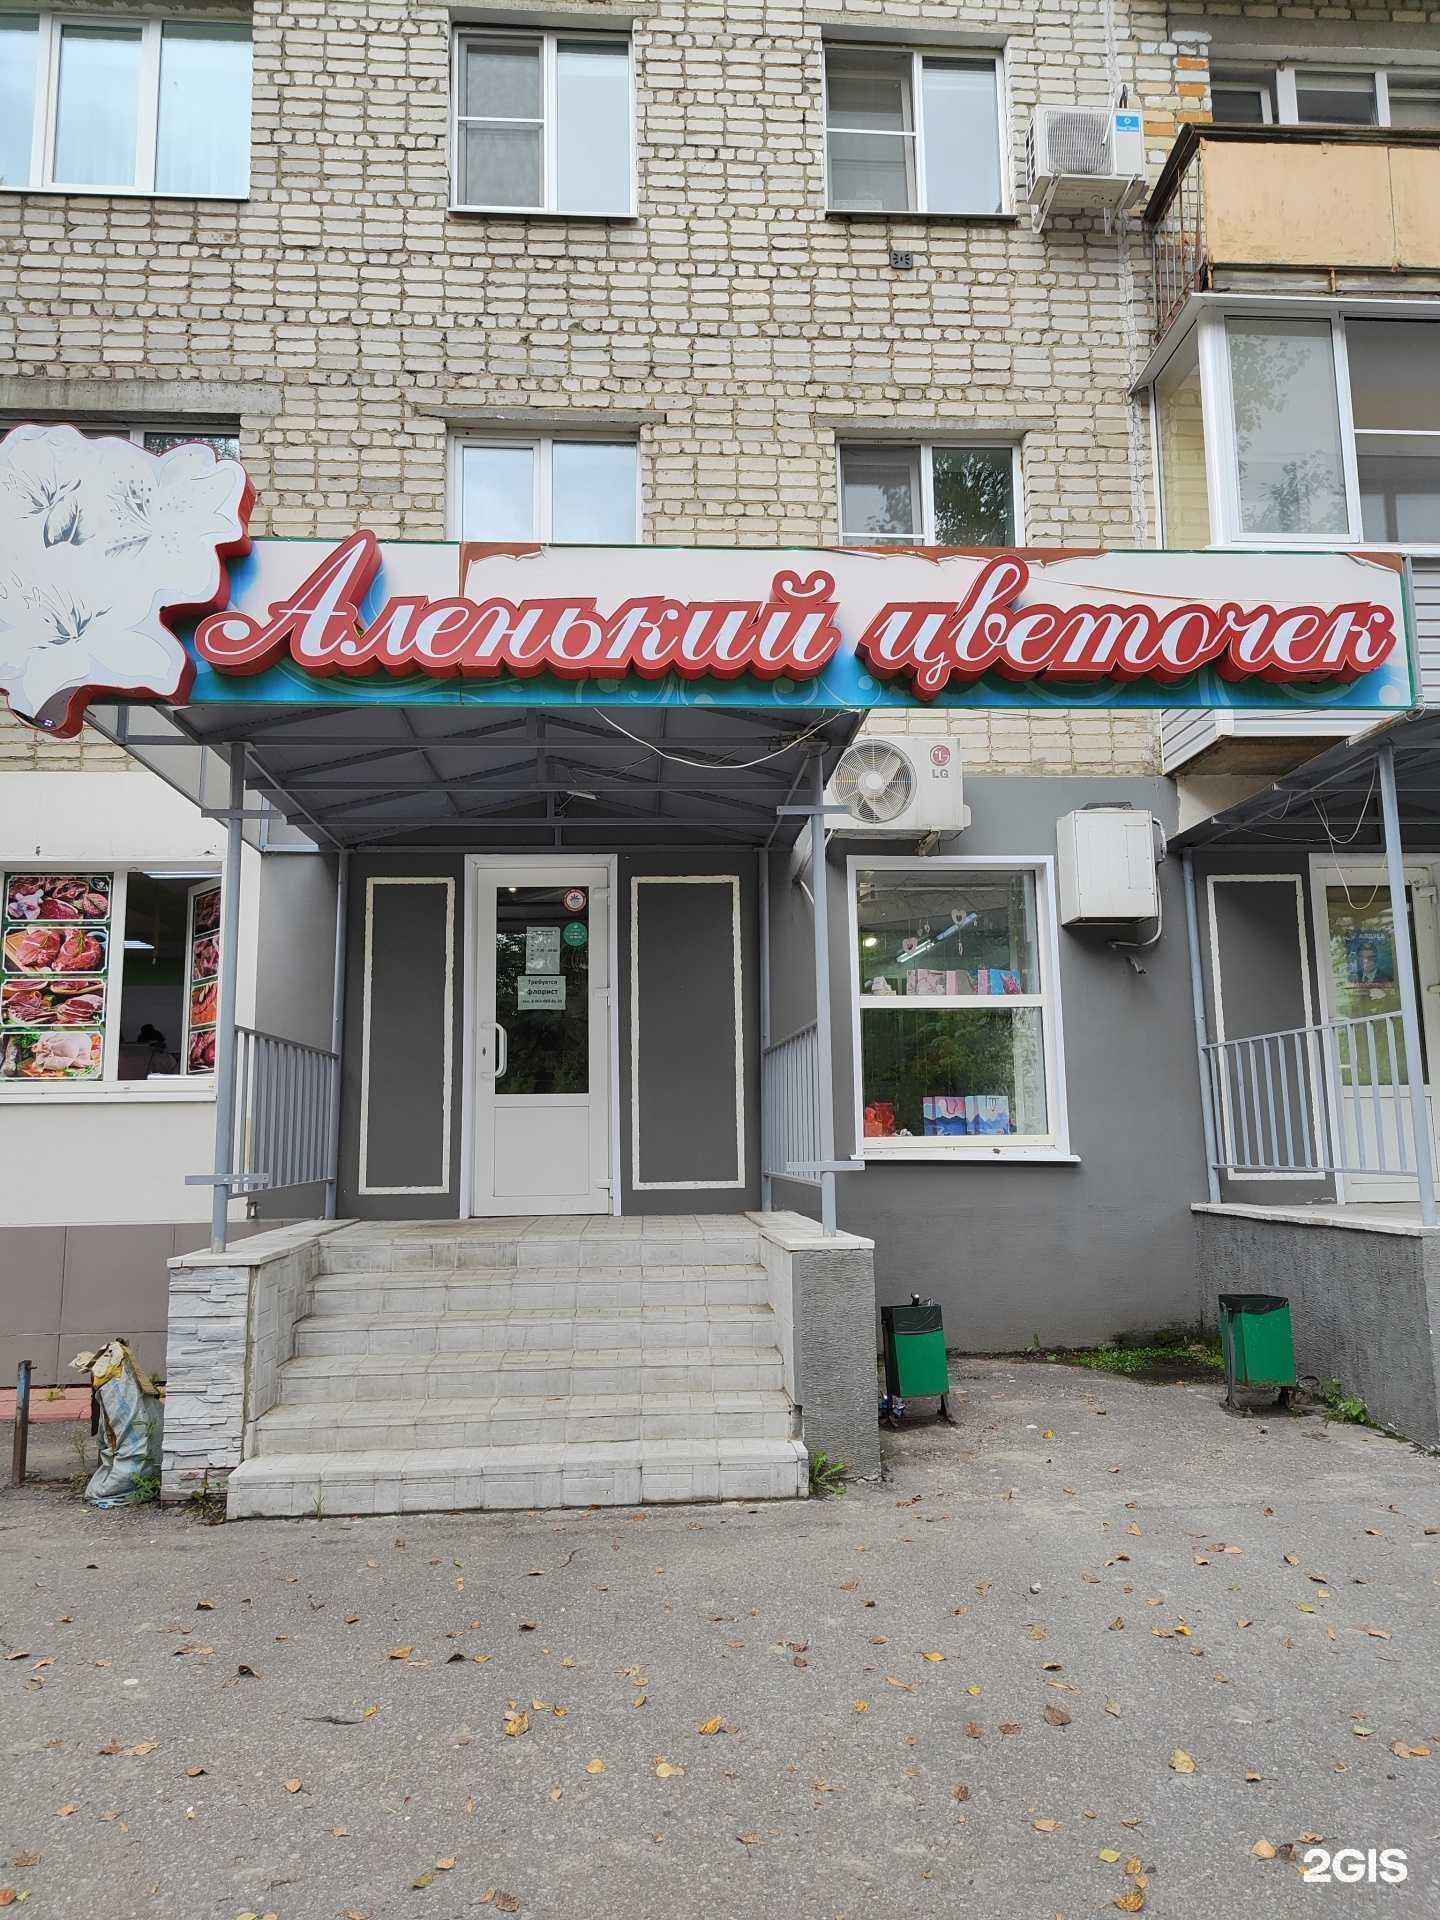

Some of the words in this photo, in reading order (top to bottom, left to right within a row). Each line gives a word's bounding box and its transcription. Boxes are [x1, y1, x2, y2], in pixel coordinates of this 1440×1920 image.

[202, 536, 836, 663] Аленький
[871, 559, 1389, 687] цветочек
[932, 769, 949, 779] LG
